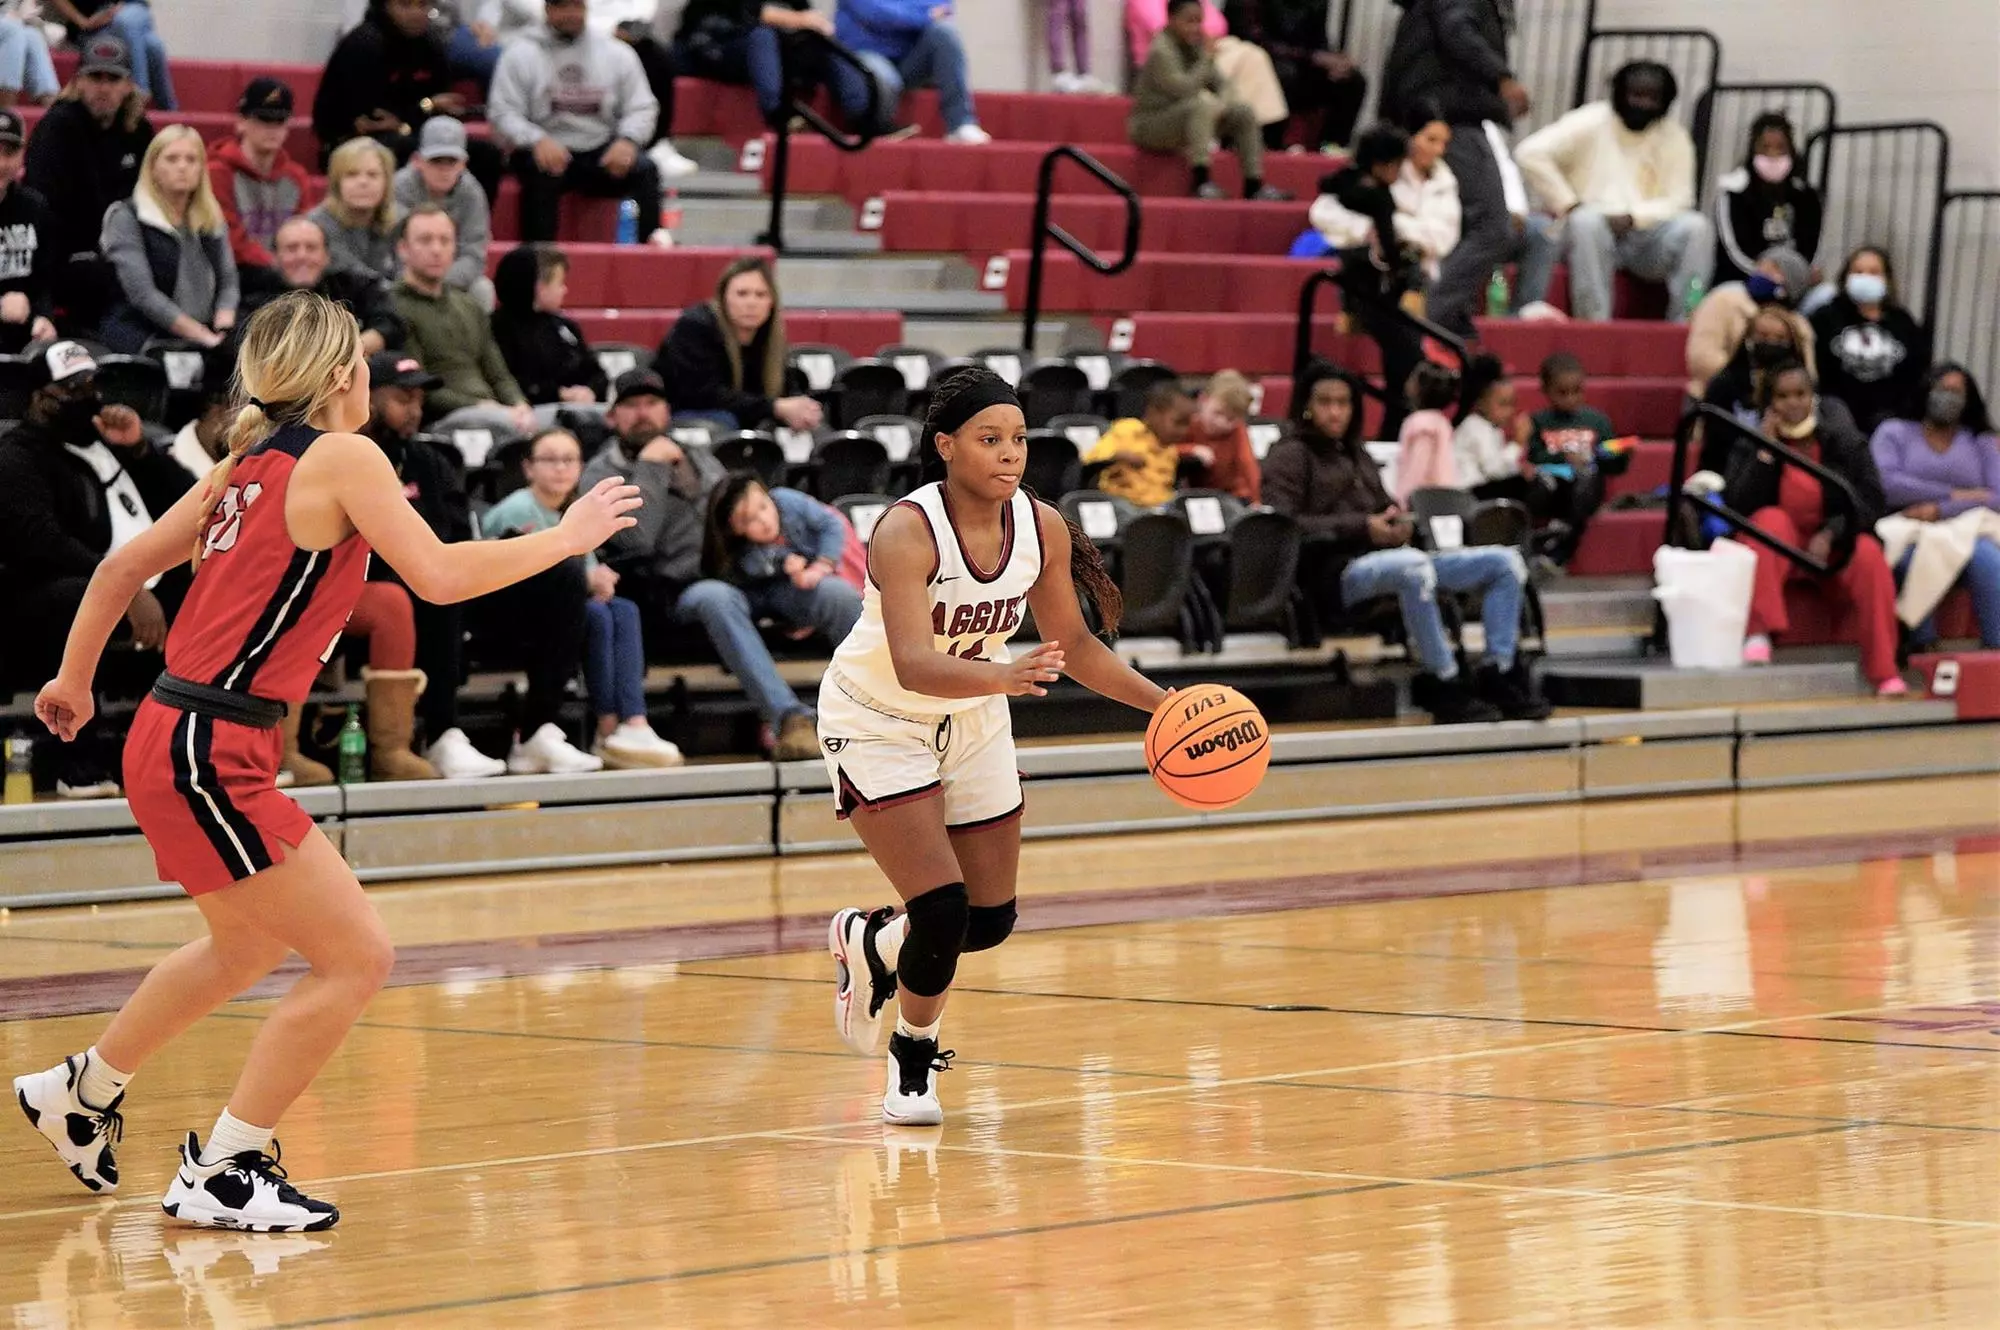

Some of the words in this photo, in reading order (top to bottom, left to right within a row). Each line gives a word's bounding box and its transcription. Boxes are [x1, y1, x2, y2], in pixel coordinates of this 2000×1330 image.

[931, 591, 1027, 638] AGGIE
[1184, 693, 1227, 720] EVO
[1184, 719, 1262, 760] Wilson
